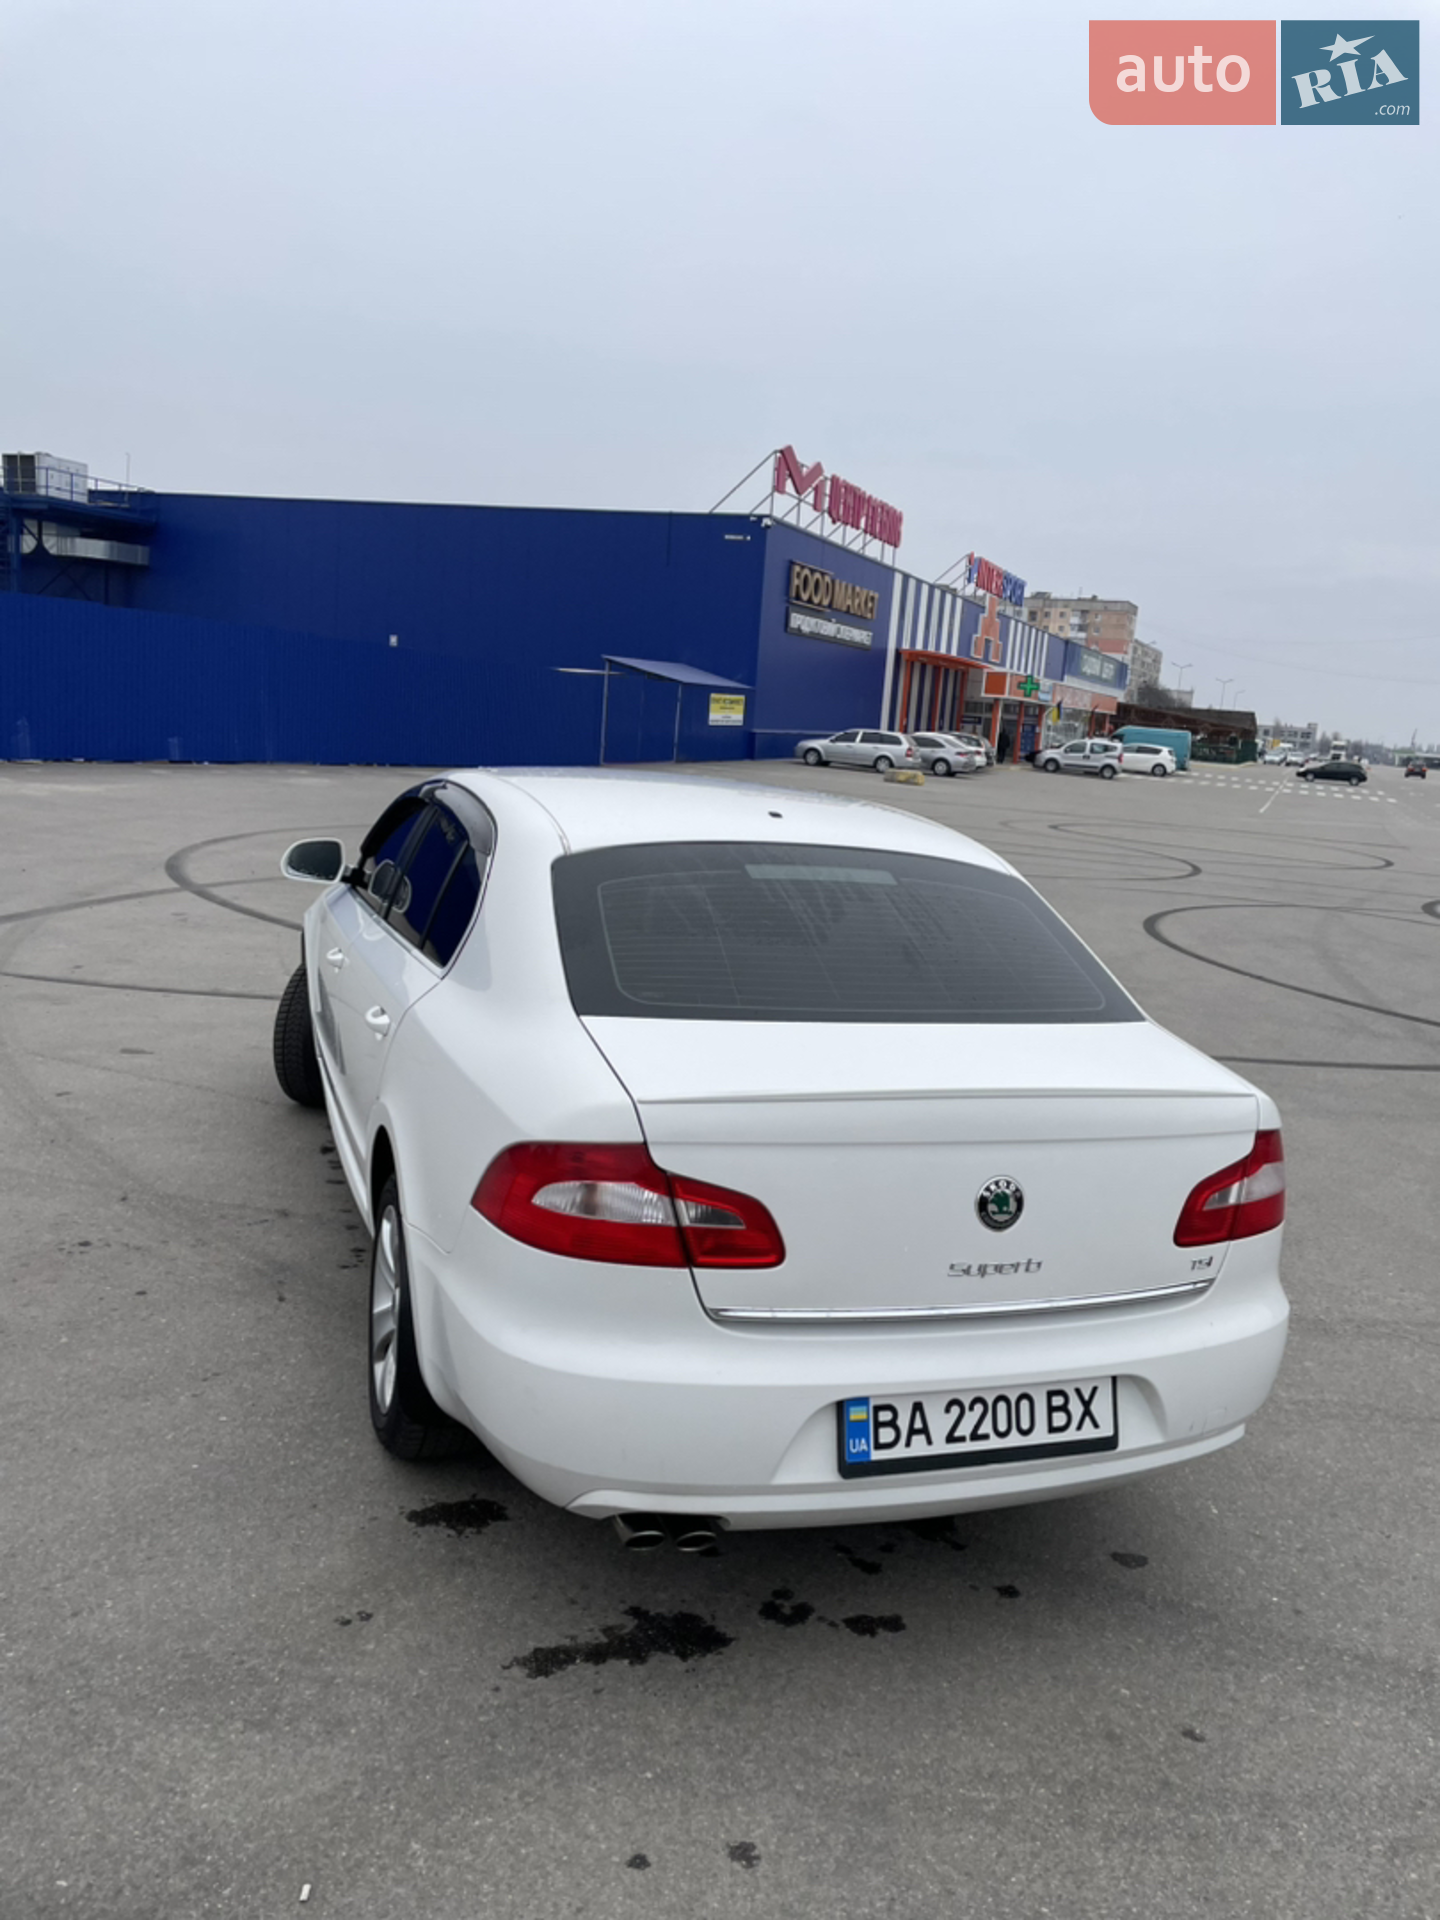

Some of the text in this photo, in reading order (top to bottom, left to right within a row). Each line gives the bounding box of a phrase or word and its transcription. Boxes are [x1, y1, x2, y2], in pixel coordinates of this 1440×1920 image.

[791, 564, 879, 620] FOOD MARKET
[947, 1258, 1043, 1279] Superb
[873, 1385, 1100, 1451] BA 2200 BX
[849, 1437, 868, 1454] UA
